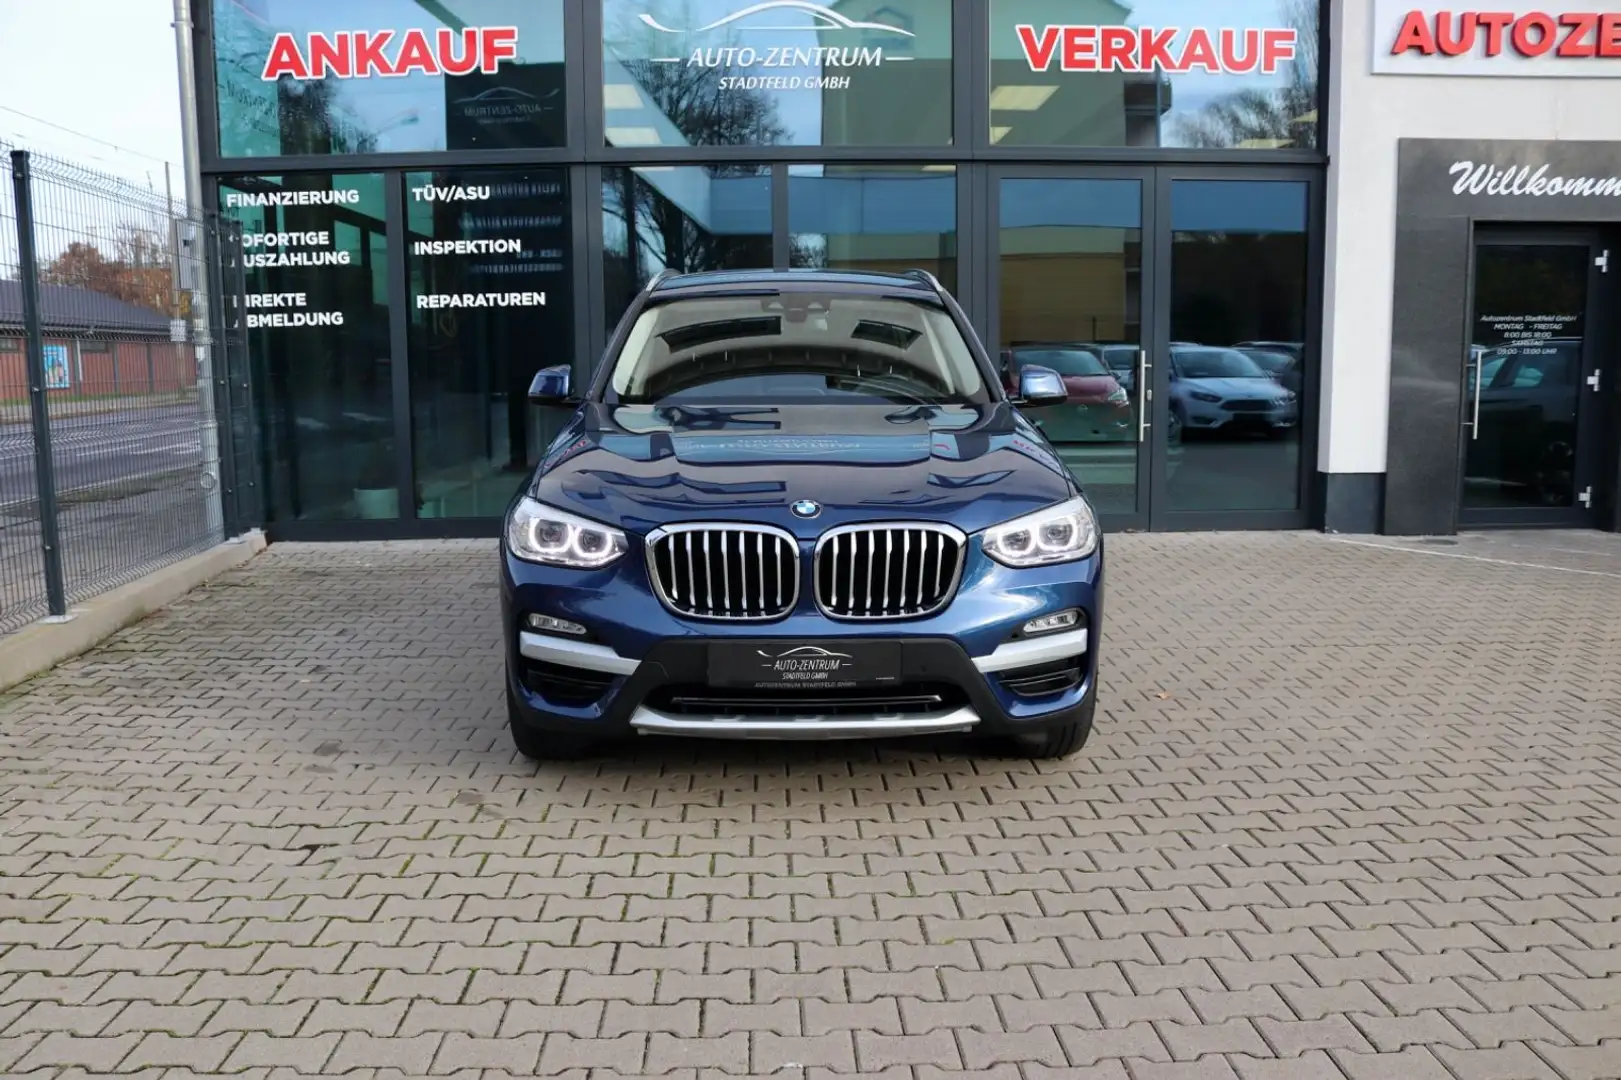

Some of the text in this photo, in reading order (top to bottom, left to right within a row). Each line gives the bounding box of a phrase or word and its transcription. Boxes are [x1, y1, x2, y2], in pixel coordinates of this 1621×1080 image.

[1391, 10, 1621, 58] AUTOZE
[262, 27, 518, 80] ANKAUF
[687, 47, 882, 67] AUTO-ZENTRUM
[1015, 25, 1298, 73] VERKAUF
[718, 76, 850, 90] STADTFELD GMBH
[226, 189, 360, 208] FINANZIERUNG
[412, 184, 490, 203] TÜV/ASU
[229, 231, 329, 247] OFORTIGE
[414, 239, 521, 255] INSPEKTION
[231, 251, 350, 268] USZAHLUNG
[233, 293, 307, 308] IREKTE
[416, 292, 546, 309] REPARATUREN
[234, 312, 344, 328] BMELDUNG
[774, 660, 840, 671] AUTO-ZENTRUM
